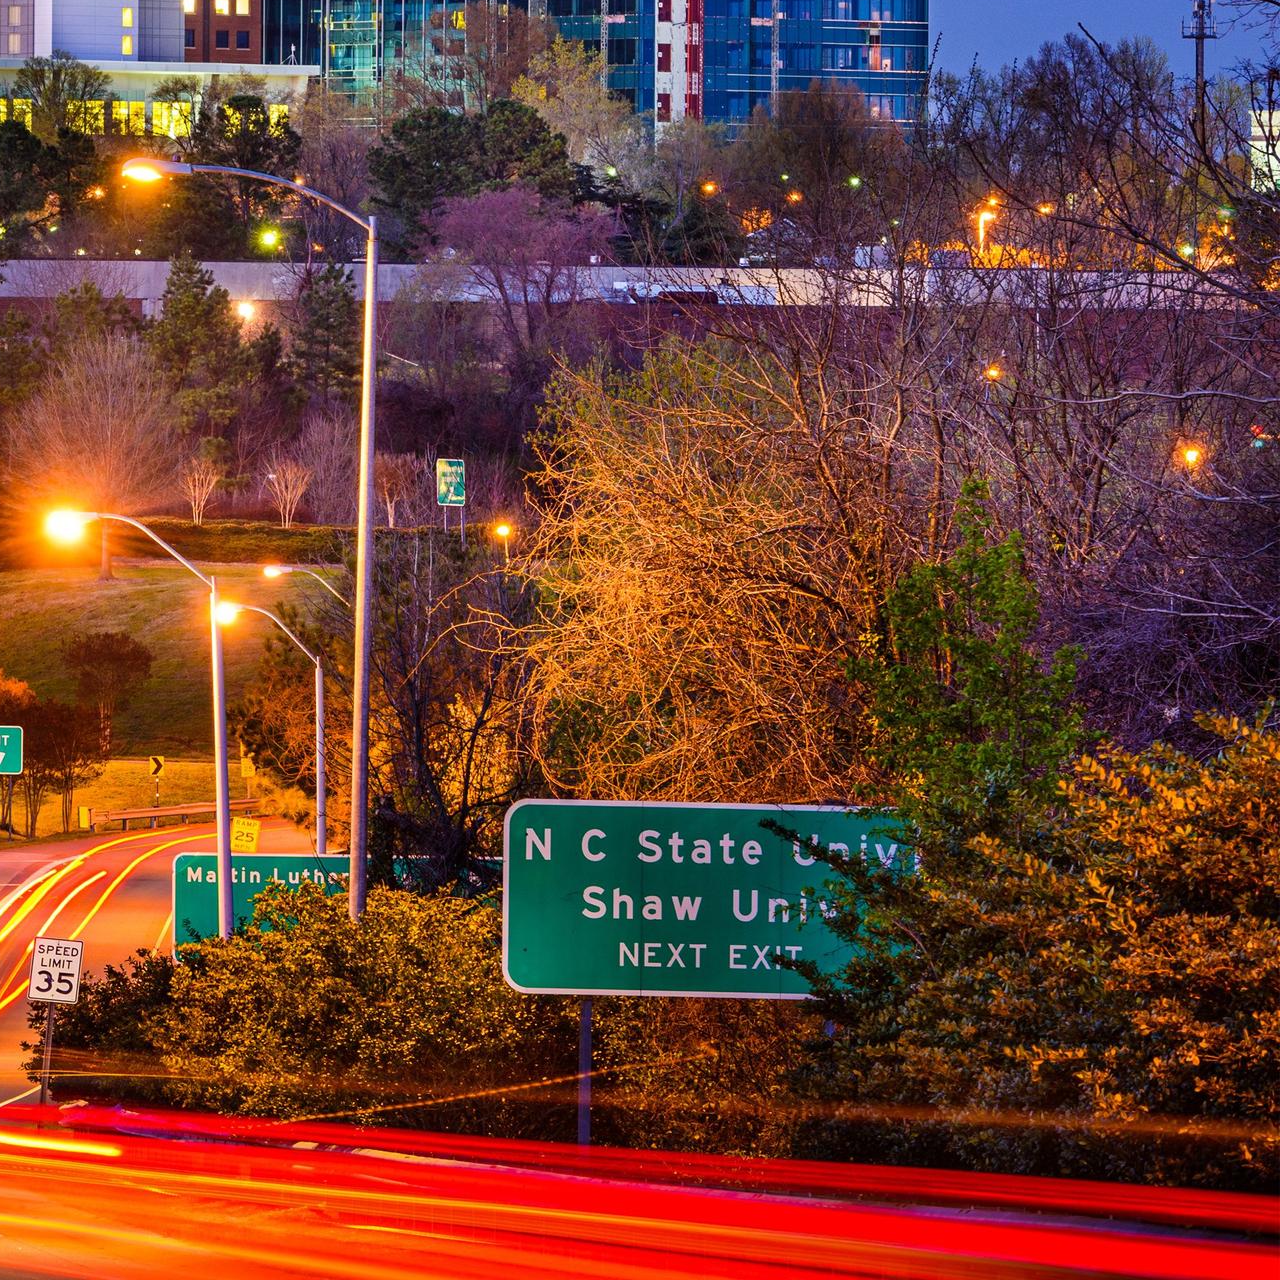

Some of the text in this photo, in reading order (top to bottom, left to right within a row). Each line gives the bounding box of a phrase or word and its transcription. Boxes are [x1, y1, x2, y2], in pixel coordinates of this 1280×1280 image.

[235, 830, 254, 842] 25
[525, 828, 552, 861] N
[581, 828, 607, 863] C
[637, 830, 763, 865] State
[187, 867, 261, 883] Matin
[581, 886, 703, 921] Shaw
[38, 944, 79, 957] SPEED
[618, 942, 803, 970] NEXT EXIT
[40, 957, 73, 969] LIMIT
[35, 970, 75, 995] 35
